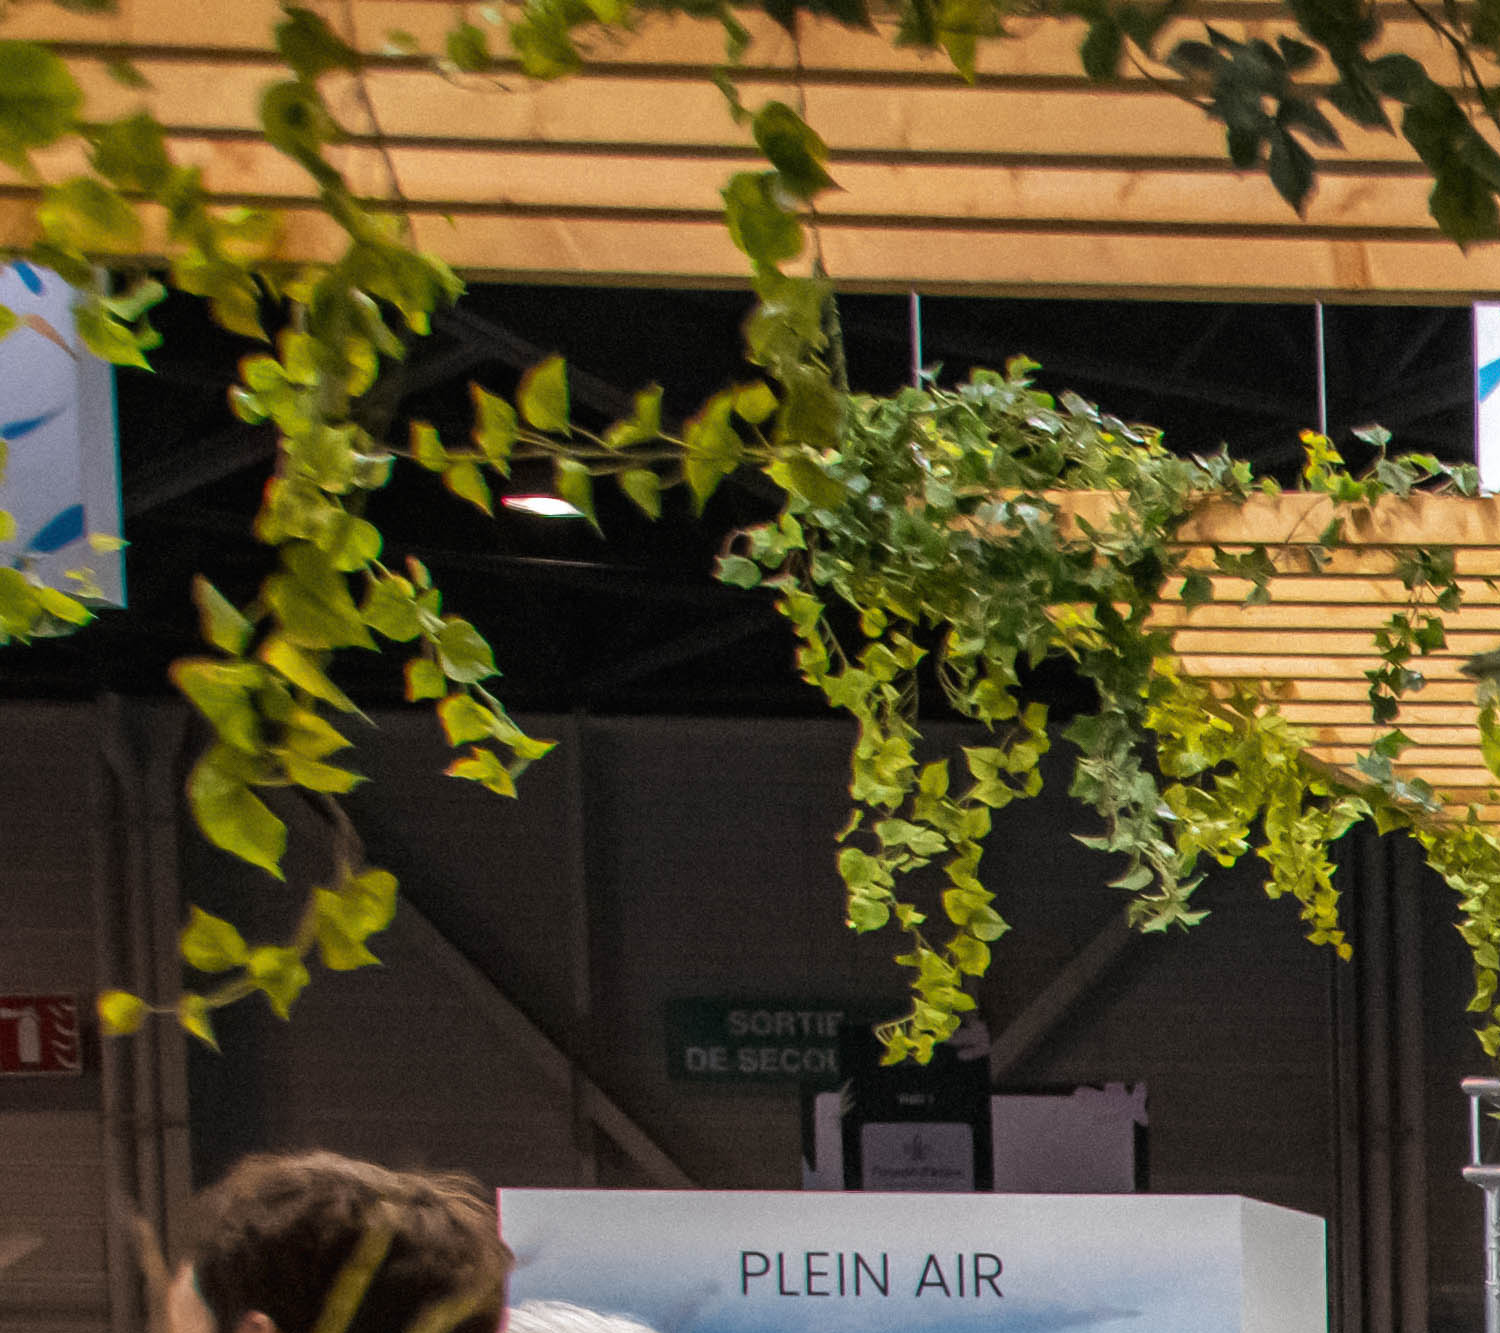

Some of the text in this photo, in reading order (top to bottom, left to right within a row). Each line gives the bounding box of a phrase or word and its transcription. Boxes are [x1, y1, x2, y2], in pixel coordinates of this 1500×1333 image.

[684, 1045, 729, 1072] DE
[740, 1250, 1004, 1298] PLEIN AIR
